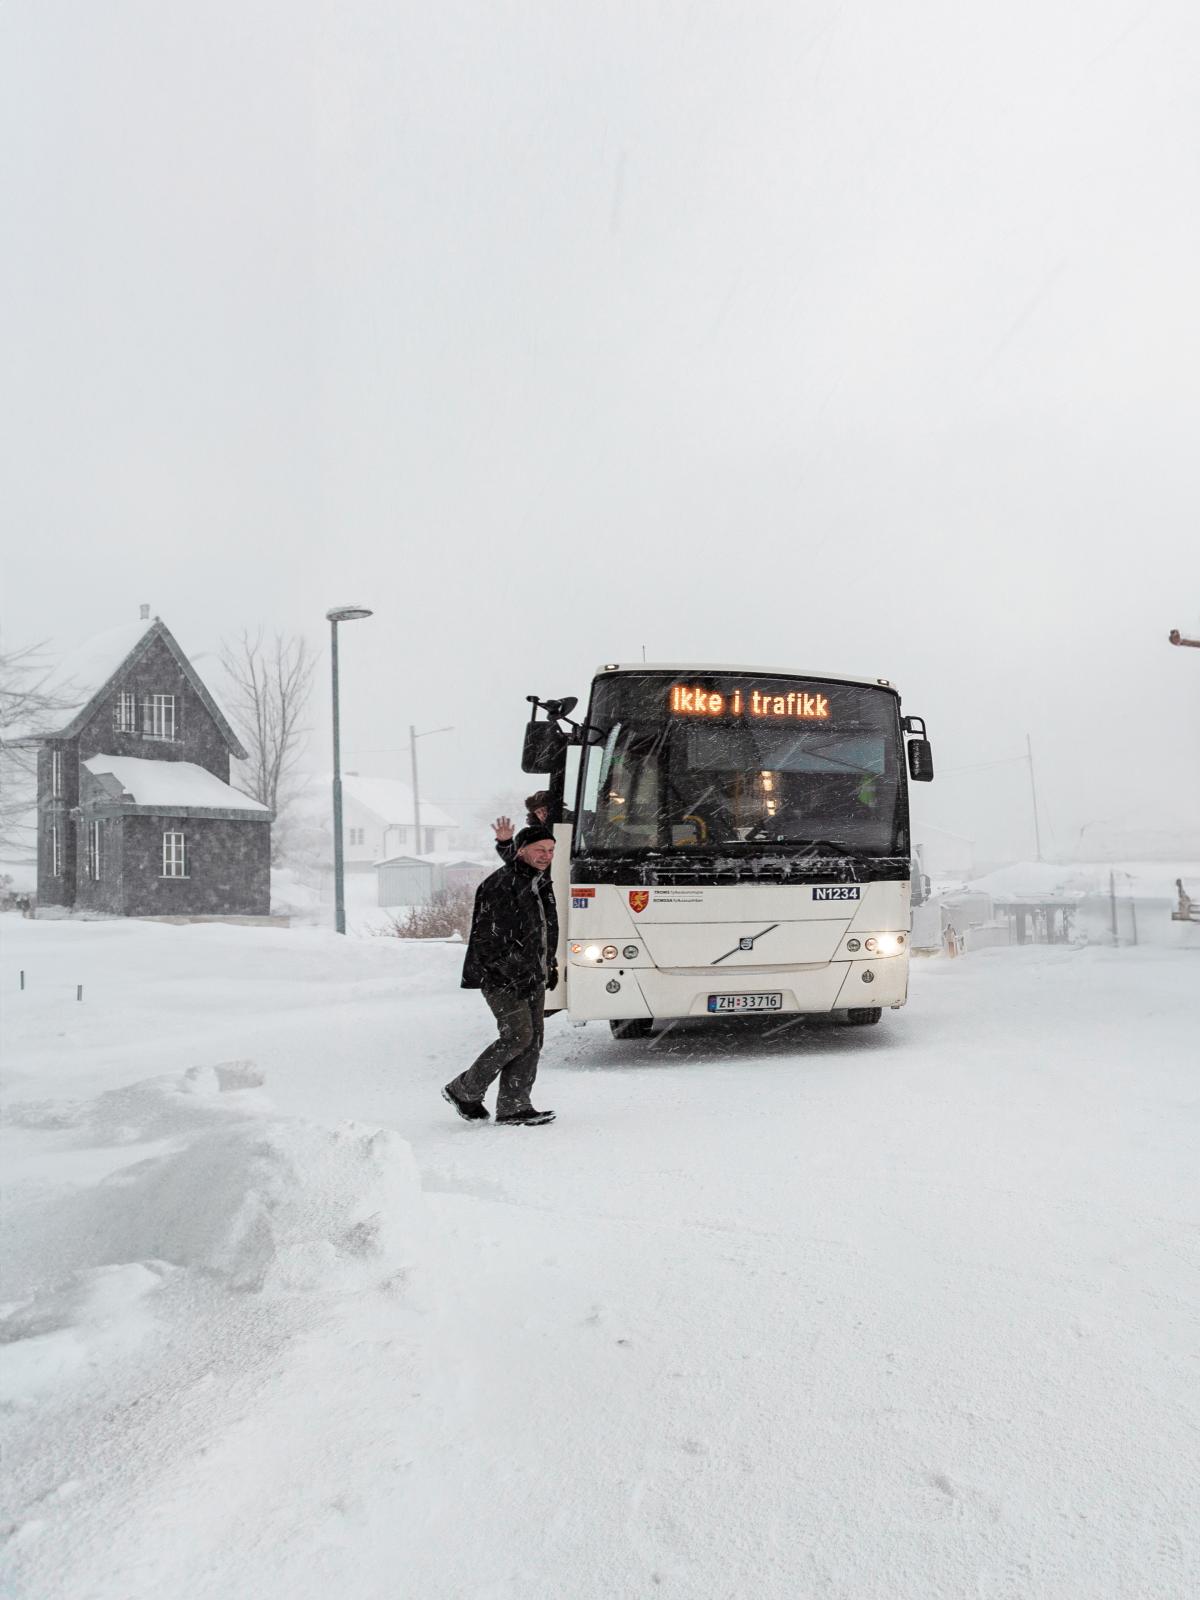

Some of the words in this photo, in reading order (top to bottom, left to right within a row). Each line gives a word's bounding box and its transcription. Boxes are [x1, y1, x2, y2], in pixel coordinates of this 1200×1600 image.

[672, 686, 723, 713] Ikke
[733, 690, 741, 713] i
[752, 690, 829, 717] trafikk
[816, 888, 858, 900] N1234
[719, 996, 735, 1008] ZH
[741, 995, 777, 1008] 33716
